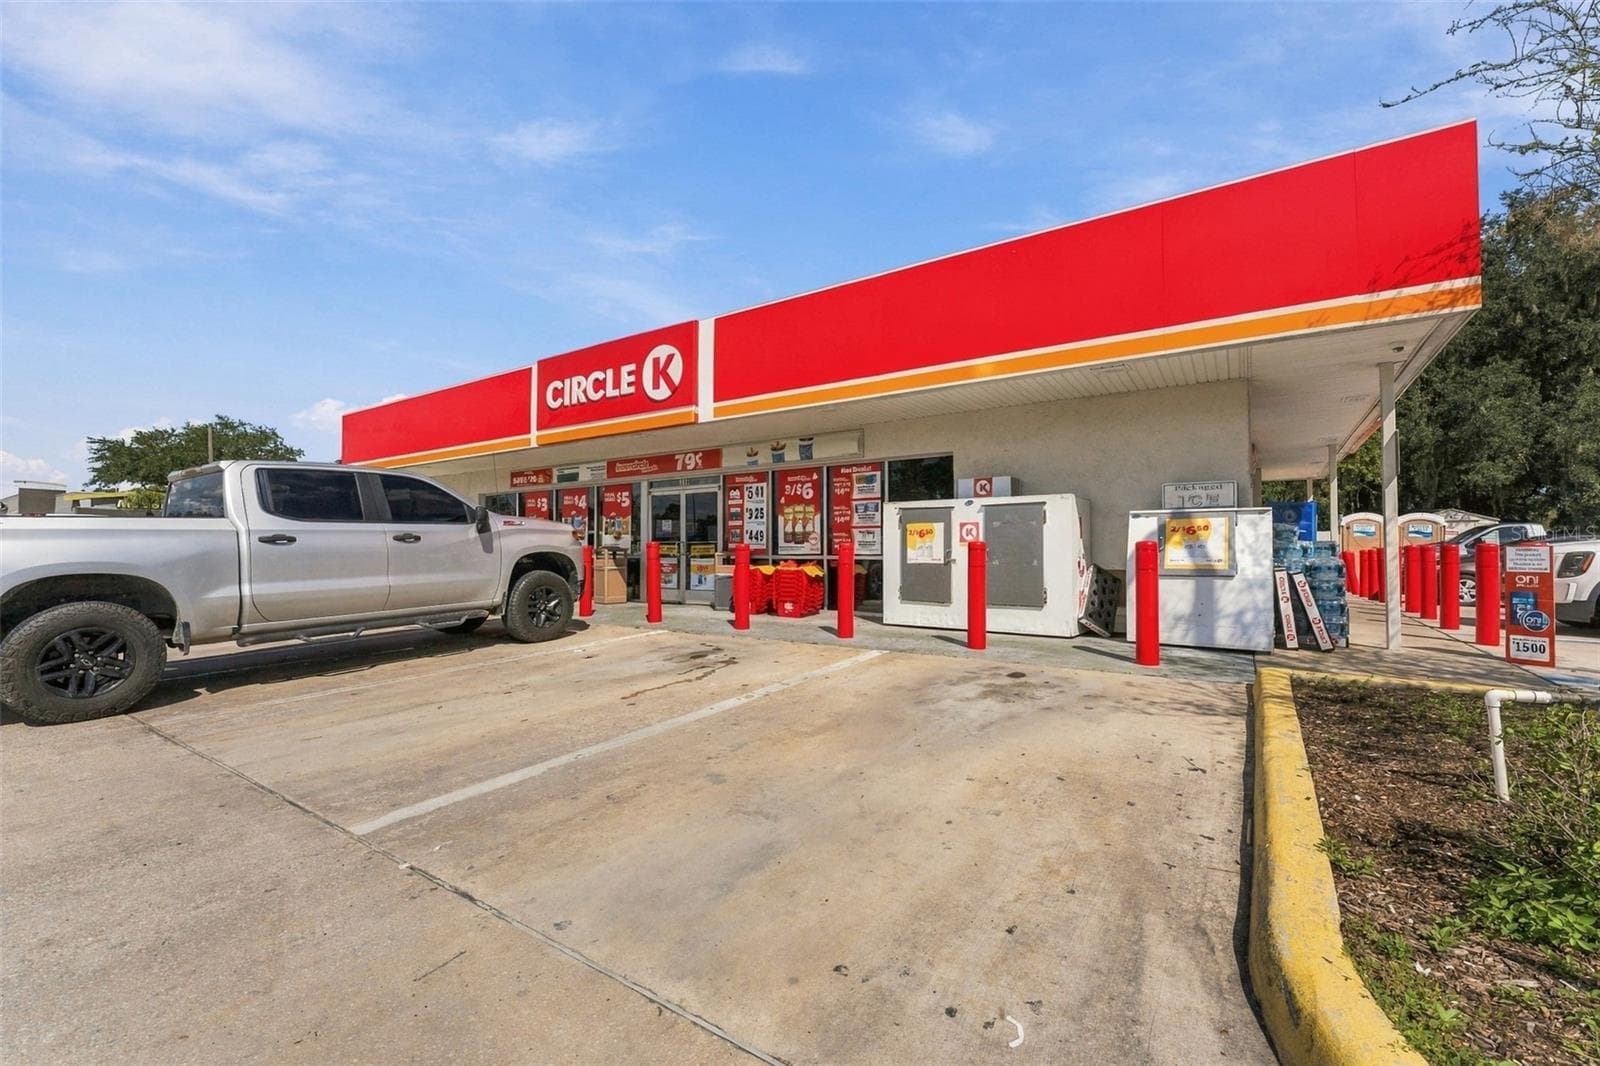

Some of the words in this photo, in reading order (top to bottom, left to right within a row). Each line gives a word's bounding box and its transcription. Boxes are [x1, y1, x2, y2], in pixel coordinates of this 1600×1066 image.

[546, 363, 637, 410] CIRCLE
[650, 351, 680, 398] K
[784, 482, 814, 500] 3/$6
[978, 482, 990, 494] K
[537, 498, 548, 512] $3
[574, 495, 587, 509] $4
[616, 491, 630, 507] $5
[964, 526, 977, 539] K
